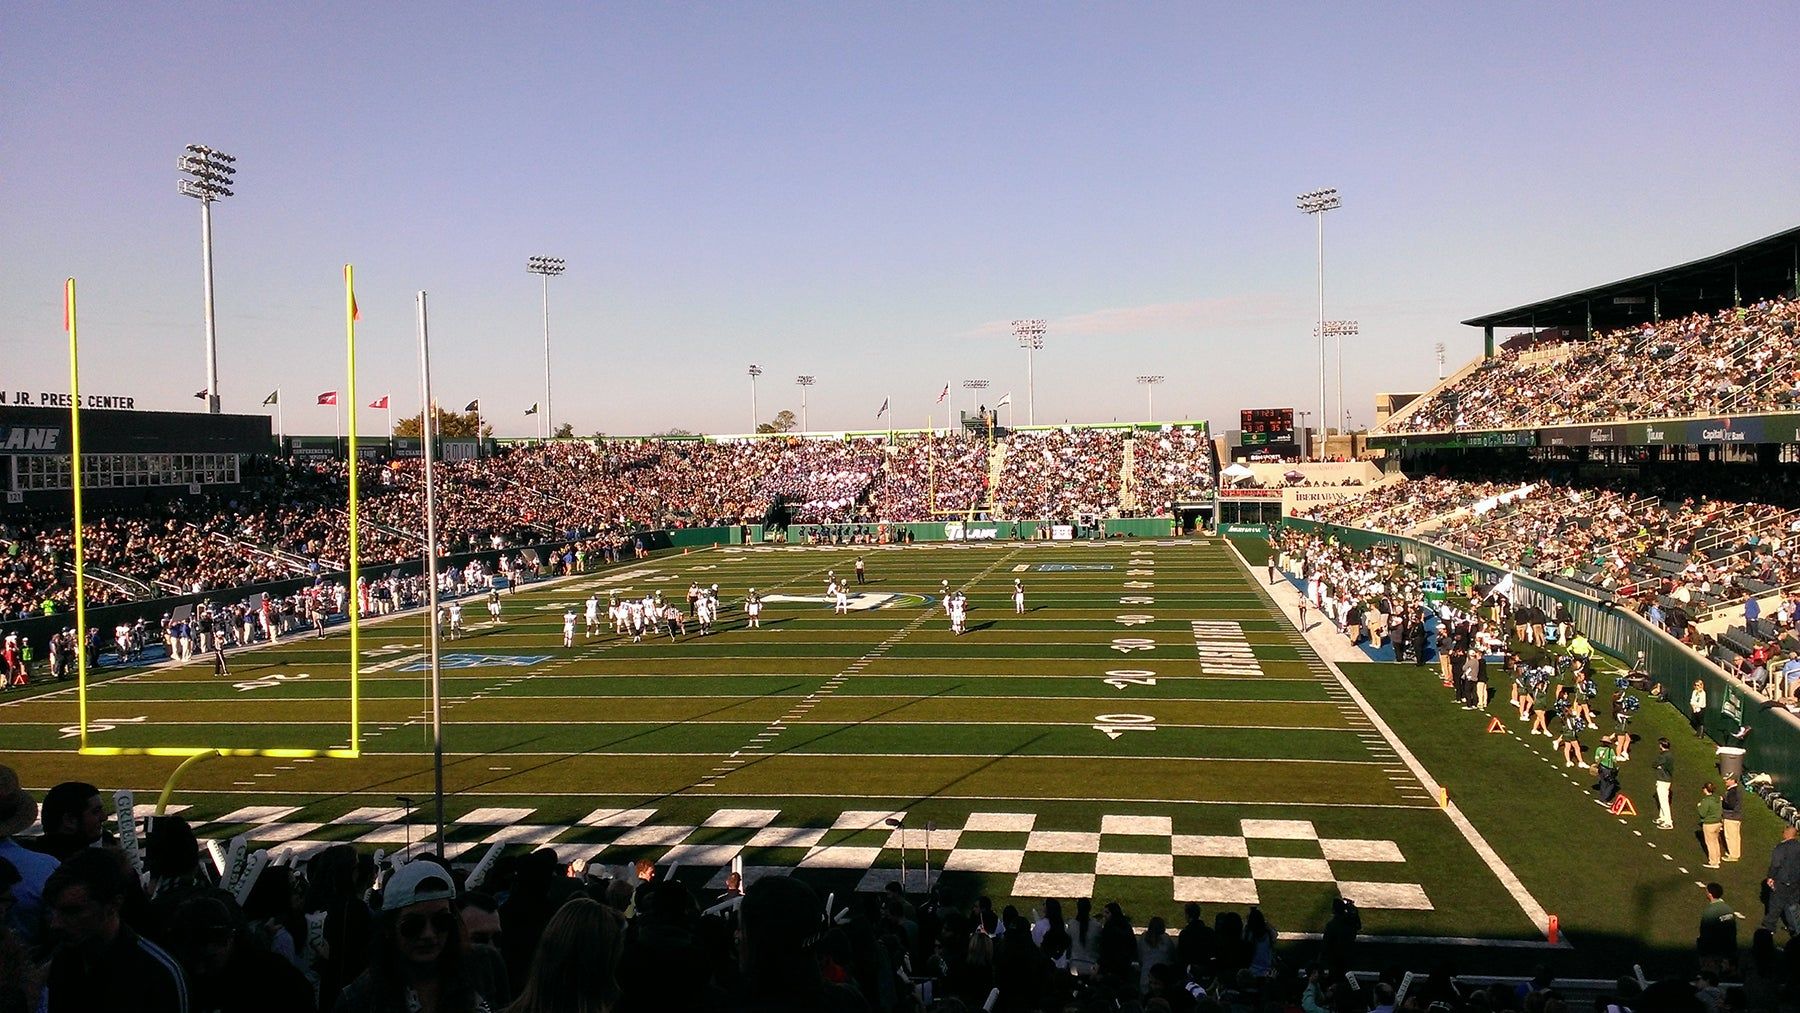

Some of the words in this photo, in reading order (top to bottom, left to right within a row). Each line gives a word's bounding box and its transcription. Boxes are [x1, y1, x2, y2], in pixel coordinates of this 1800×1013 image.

[13, 391, 35, 405] JR.
[41, 393, 82, 407] PRESS
[88, 395, 135, 409] CENTER
[1702, 429, 1723, 441] Capital
[1732, 432, 1744, 441] Bank
[947, 524, 997, 541] TULANE
[1093, 713, 1156, 731] 10
